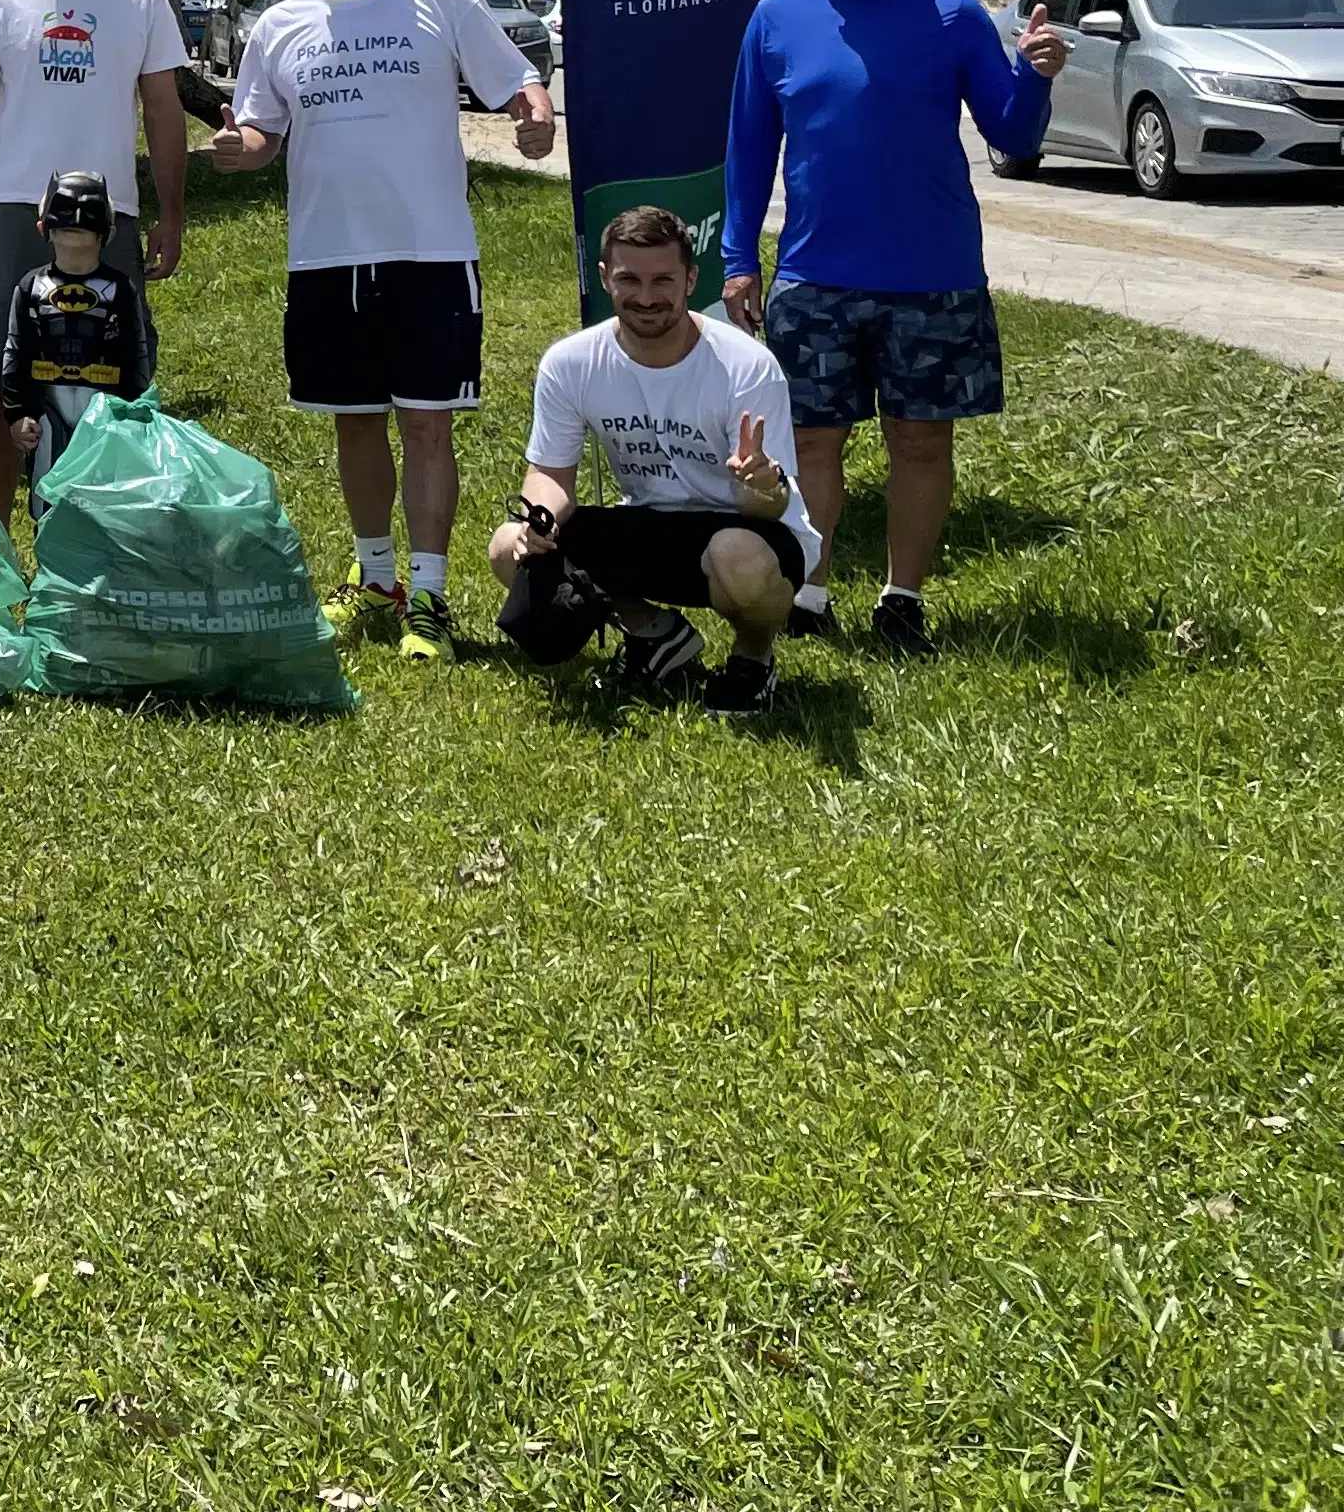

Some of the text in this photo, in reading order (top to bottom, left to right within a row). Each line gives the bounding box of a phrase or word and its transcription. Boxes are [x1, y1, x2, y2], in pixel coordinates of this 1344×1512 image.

[39, 48, 95, 68] LAGOA
[296, 36, 413, 61] PRAIA LIMPA
[296, 59, 420, 85] É PRAIA MAIS
[299, 88, 363, 109] BONITA
[601, 414, 653, 432] PRAI
[626, 442, 672, 460] PRA
[218, 581, 282, 606] onda
